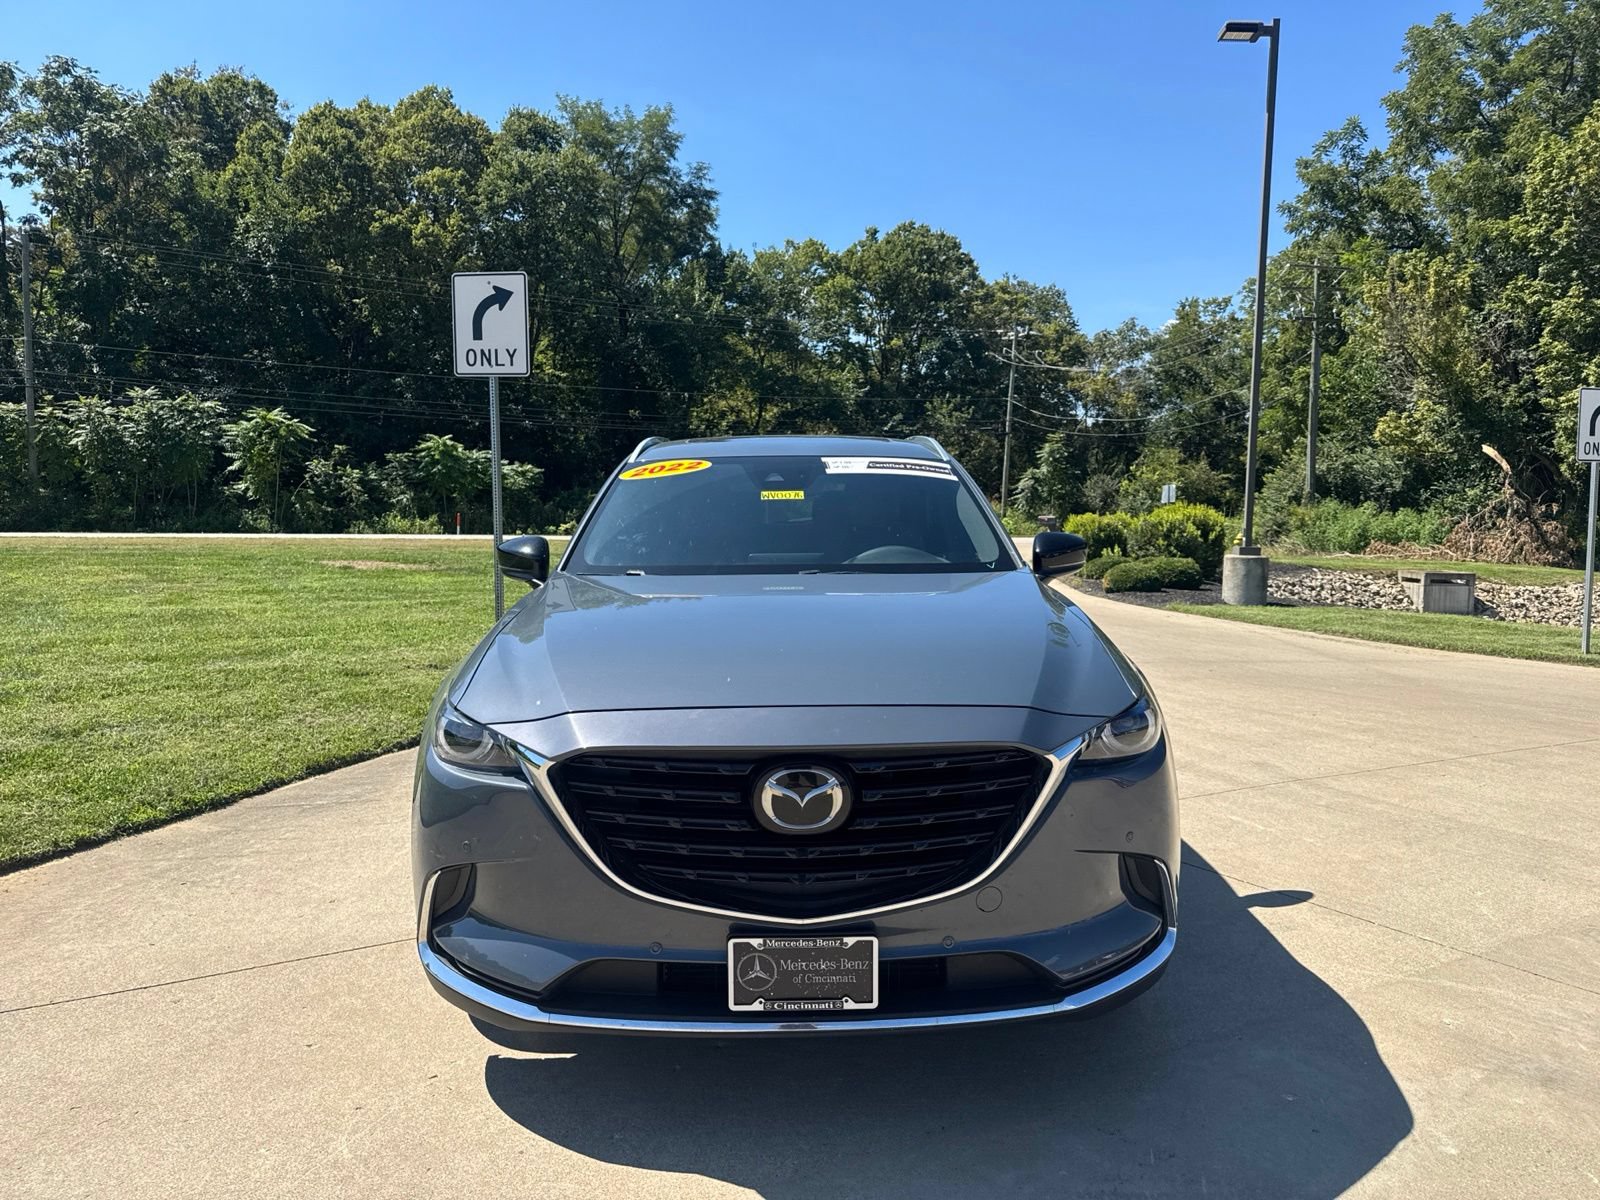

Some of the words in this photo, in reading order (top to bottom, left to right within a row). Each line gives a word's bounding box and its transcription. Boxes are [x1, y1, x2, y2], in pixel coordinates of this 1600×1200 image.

[465, 348, 518, 368] ONLY
[630, 462, 703, 478] 2022
[905, 463, 950, 474] Pre-Owned
[766, 939, 841, 948] Mercedes-Benz
[780, 959, 869, 971] Mercedes-Benz
[793, 974, 803, 984] of
[804, 973, 857, 984] Cincinnati
[774, 1001, 834, 1010] Cincinnati
